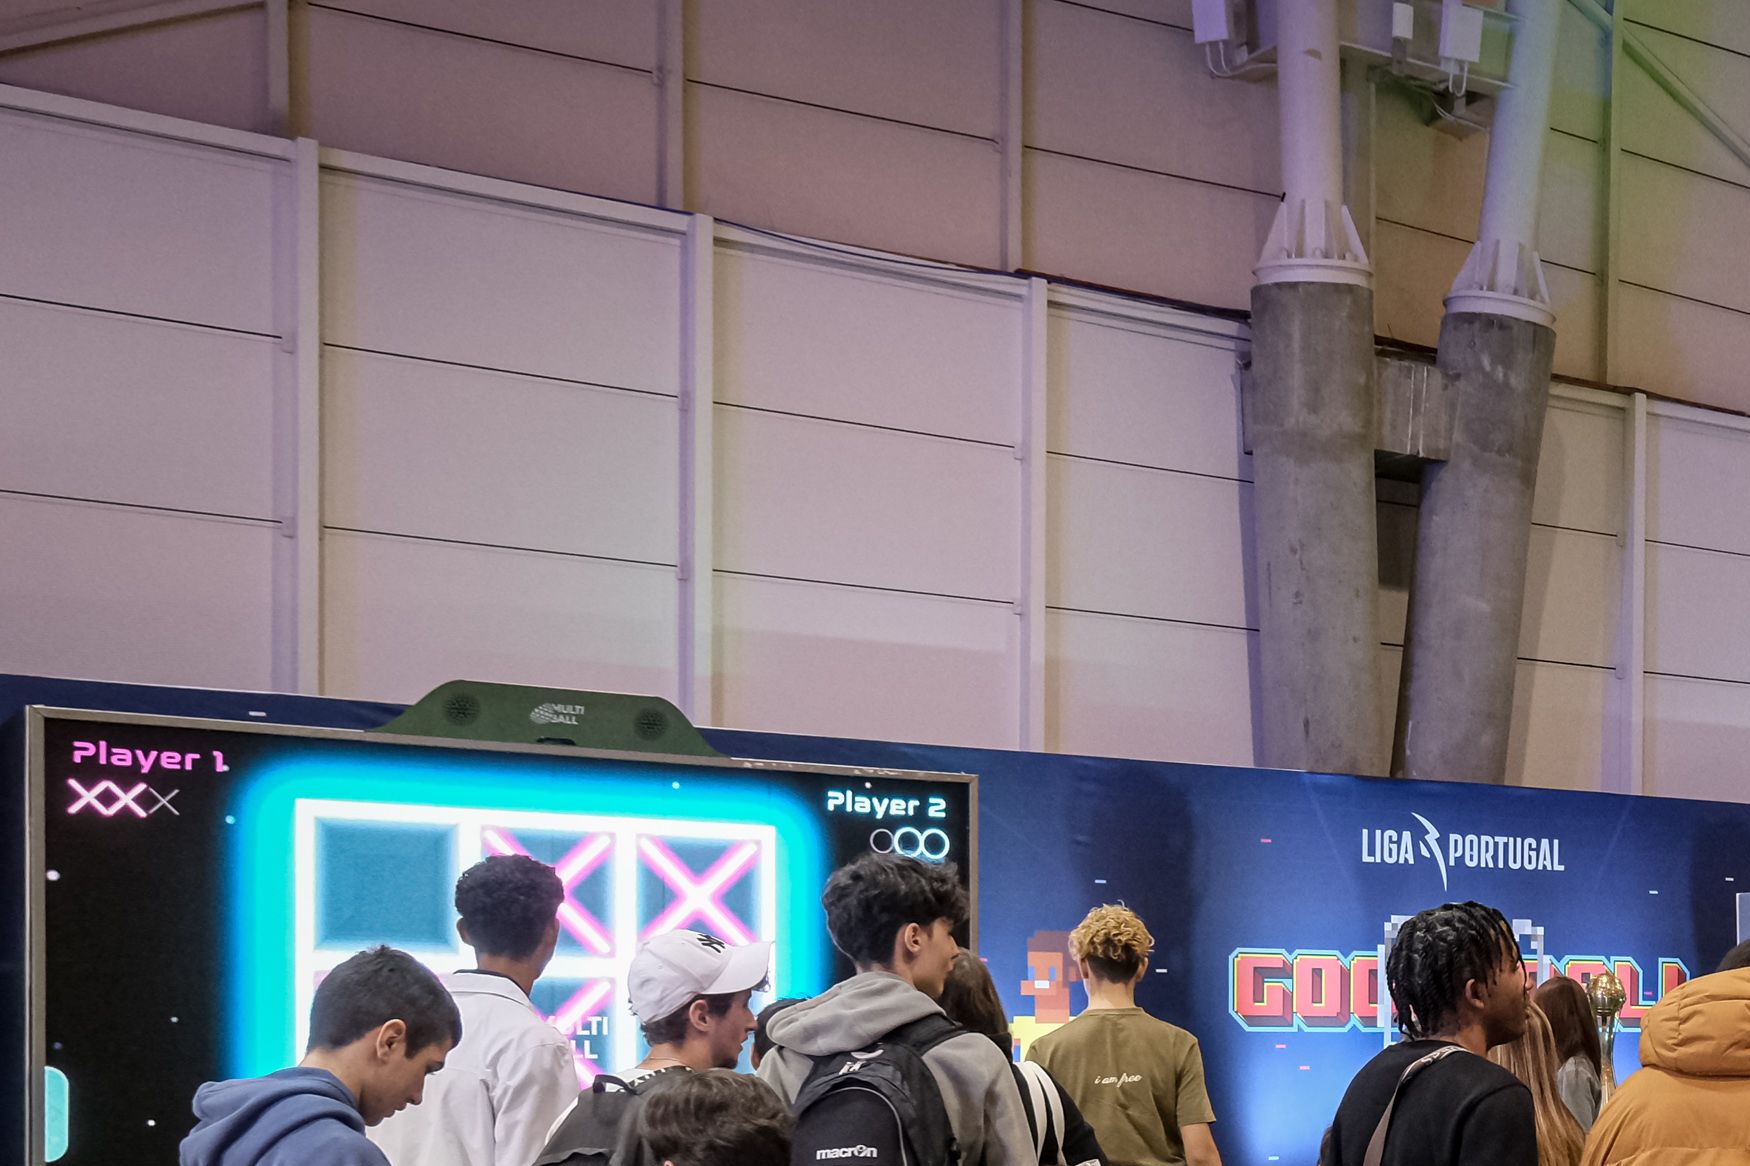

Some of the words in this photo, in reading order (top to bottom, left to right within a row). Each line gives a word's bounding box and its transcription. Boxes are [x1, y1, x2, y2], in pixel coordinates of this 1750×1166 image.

[72, 740, 201, 773] Player
[212, 751, 229, 772] 1
[827, 789, 920, 819] Player
[927, 797, 947, 818] 2
[1361, 828, 1415, 865] LIGA
[1449, 833, 1565, 871] PORTUGAL
[816, 1144, 878, 1160] macron
